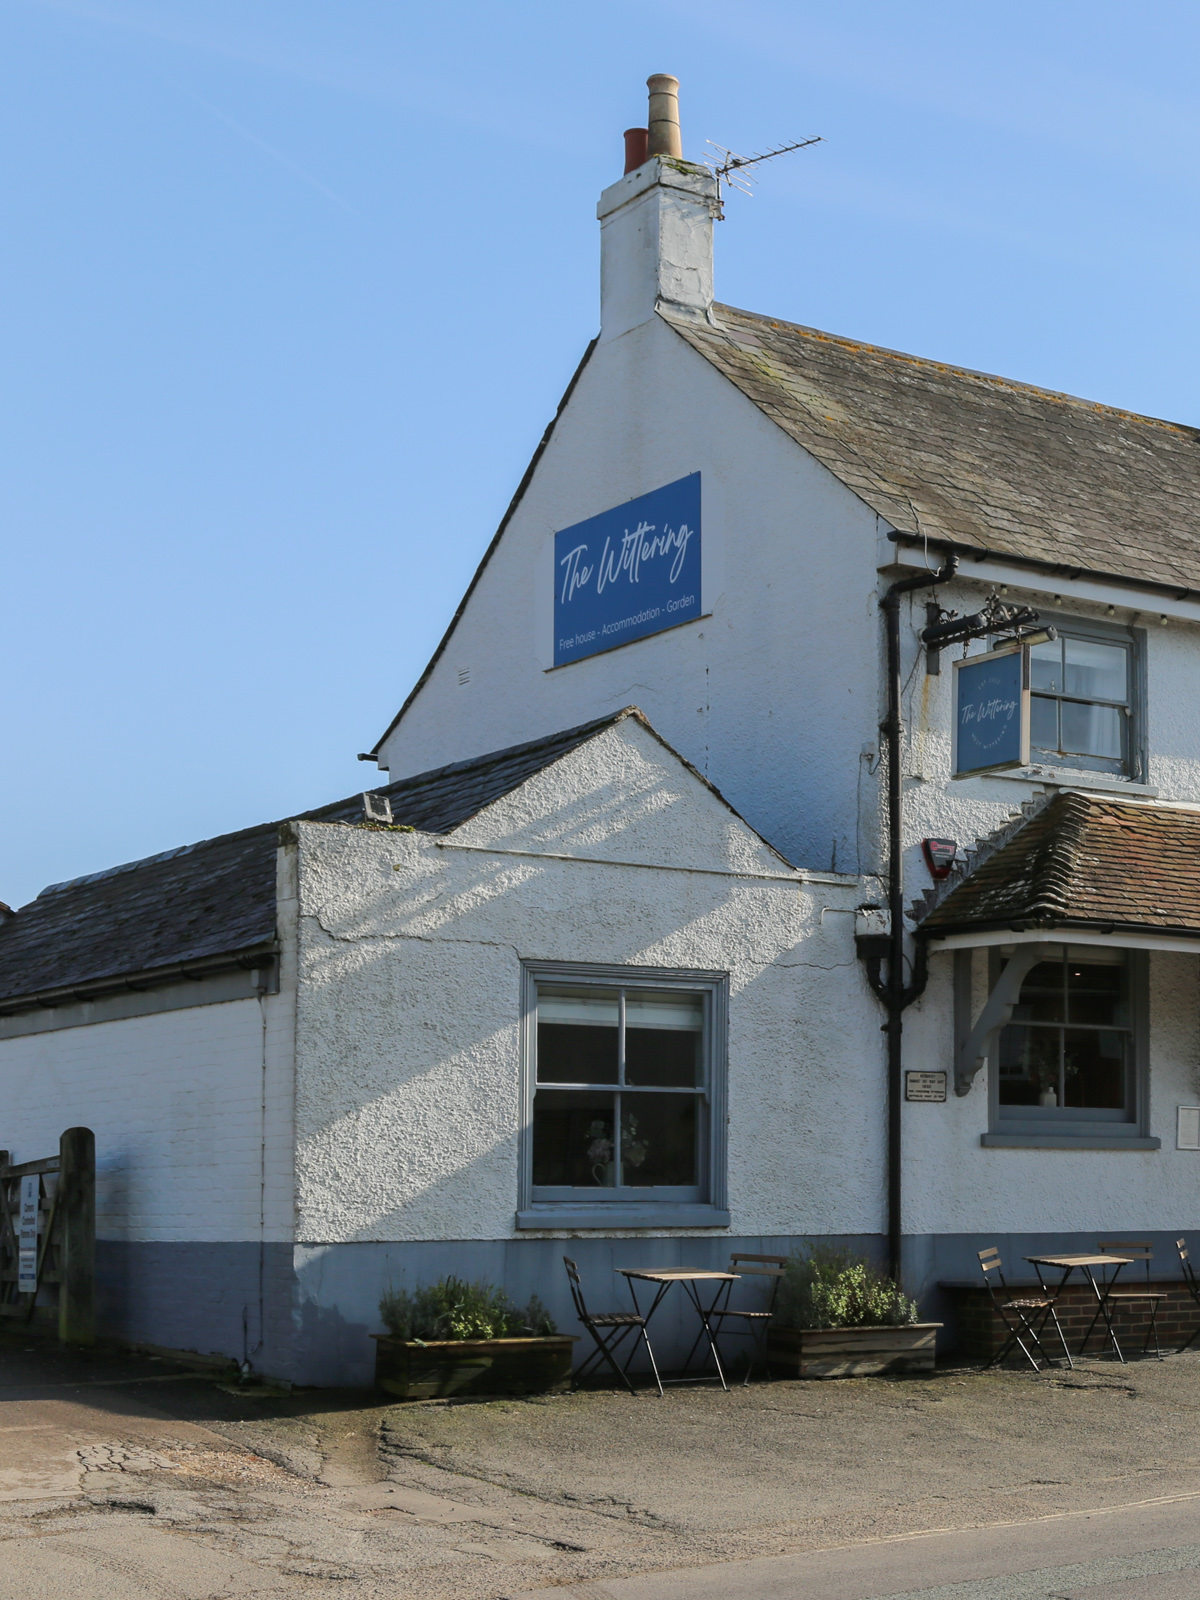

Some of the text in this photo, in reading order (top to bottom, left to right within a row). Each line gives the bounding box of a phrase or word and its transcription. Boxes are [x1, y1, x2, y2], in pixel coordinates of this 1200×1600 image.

[561, 521, 693, 604] The Wittering
[559, 639, 574, 650] Free
[575, 630, 596, 645] house
[602, 607, 660, 635] Accommodation
[667, 594, 695, 613] Garden
[962, 698, 1018, 724] The Wittering
